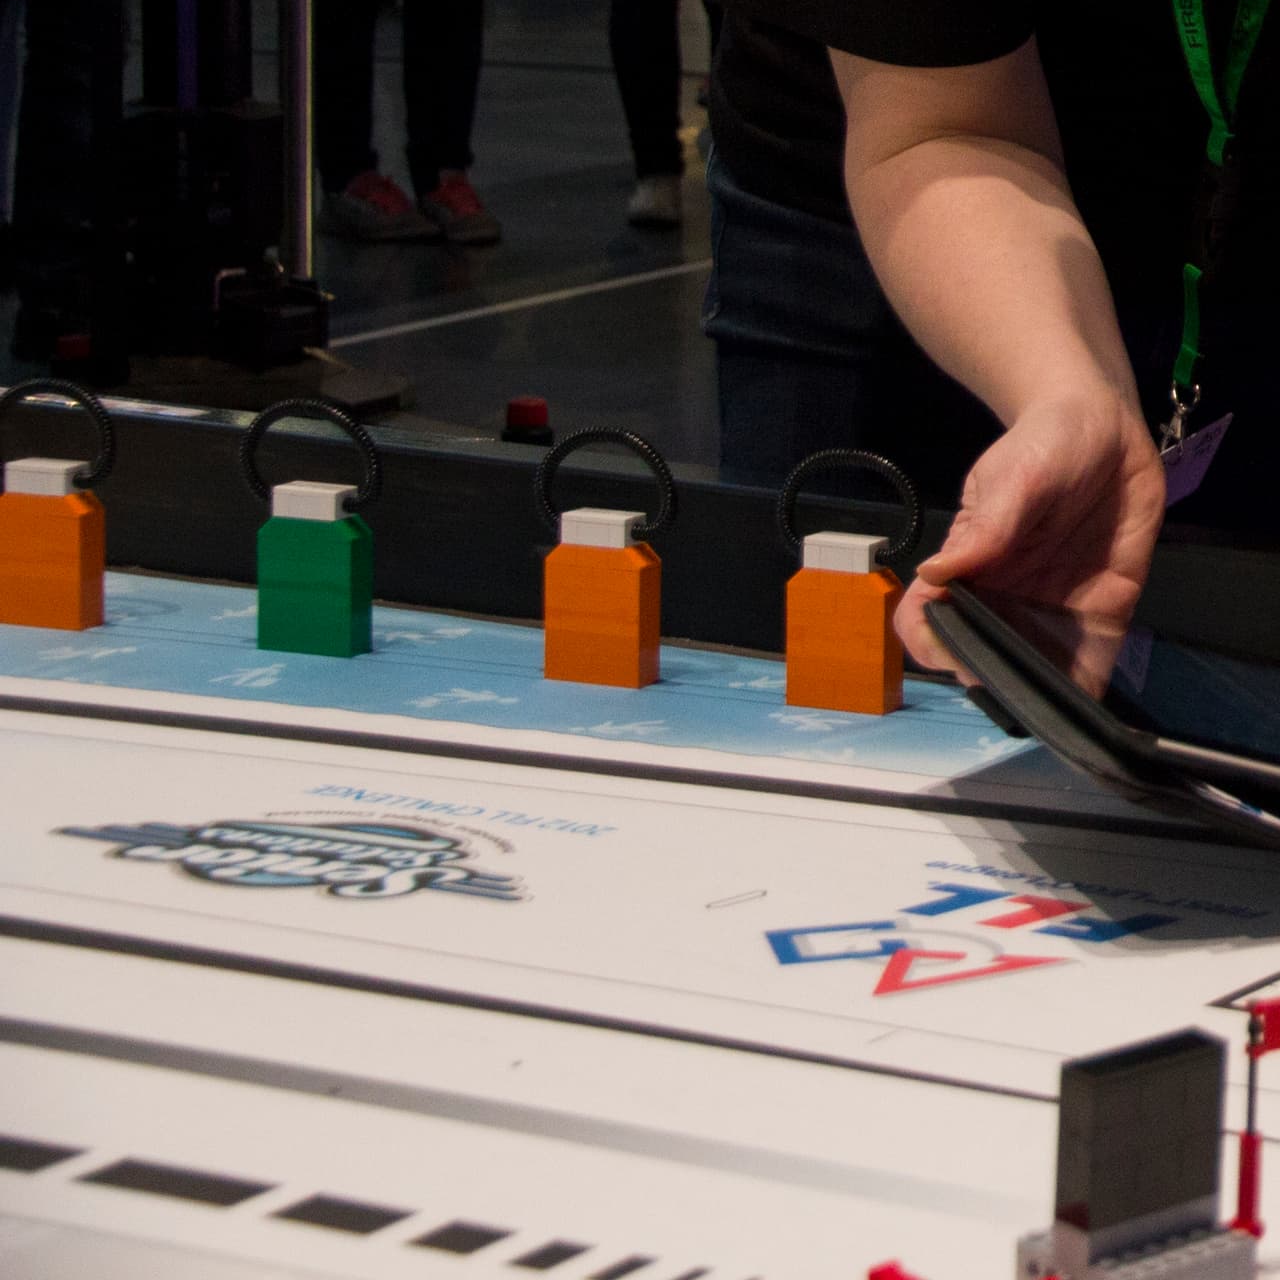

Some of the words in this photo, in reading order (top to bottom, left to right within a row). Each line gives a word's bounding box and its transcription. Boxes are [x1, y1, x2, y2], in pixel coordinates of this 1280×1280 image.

[304, 784, 485, 817] CHALLENGE
[114, 844, 474, 899] Senior
[901, 882, 1179, 943] FLL
